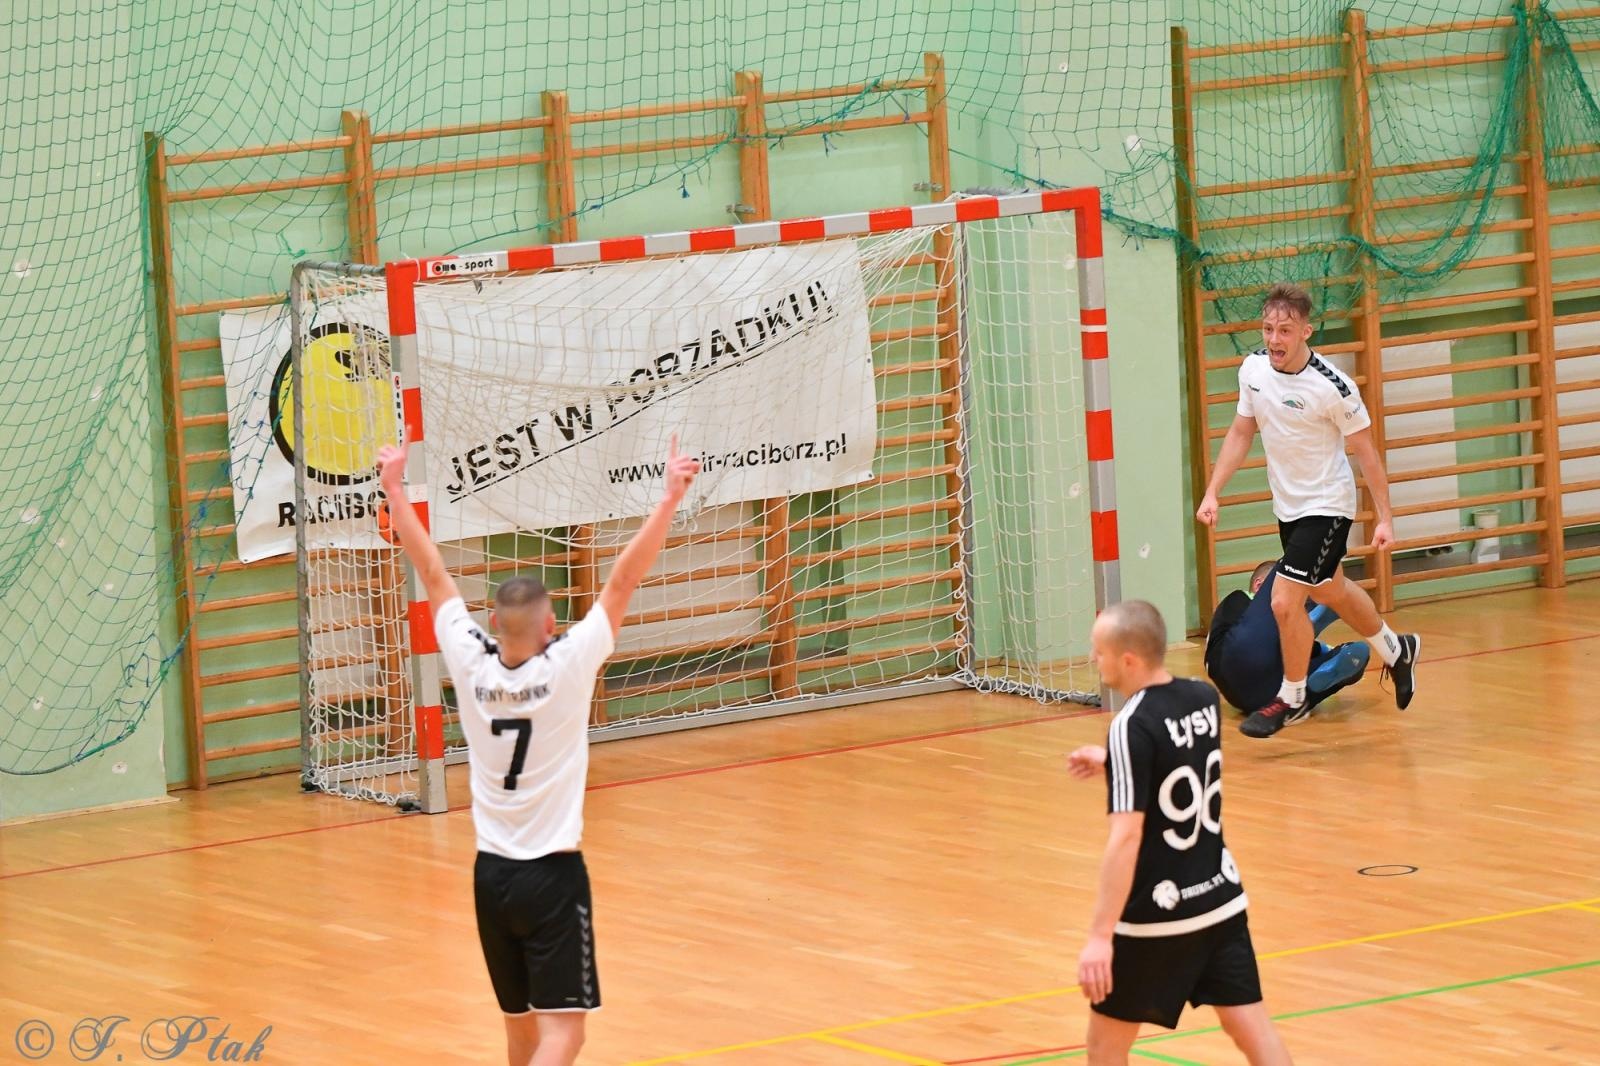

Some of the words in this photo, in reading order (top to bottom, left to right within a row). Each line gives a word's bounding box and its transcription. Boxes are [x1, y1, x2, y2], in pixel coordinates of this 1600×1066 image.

[465, 258, 493, 272] sport
[446, 418, 541, 495] JEST
[550, 397, 593, 442] W
[491, 718, 532, 790] 7
